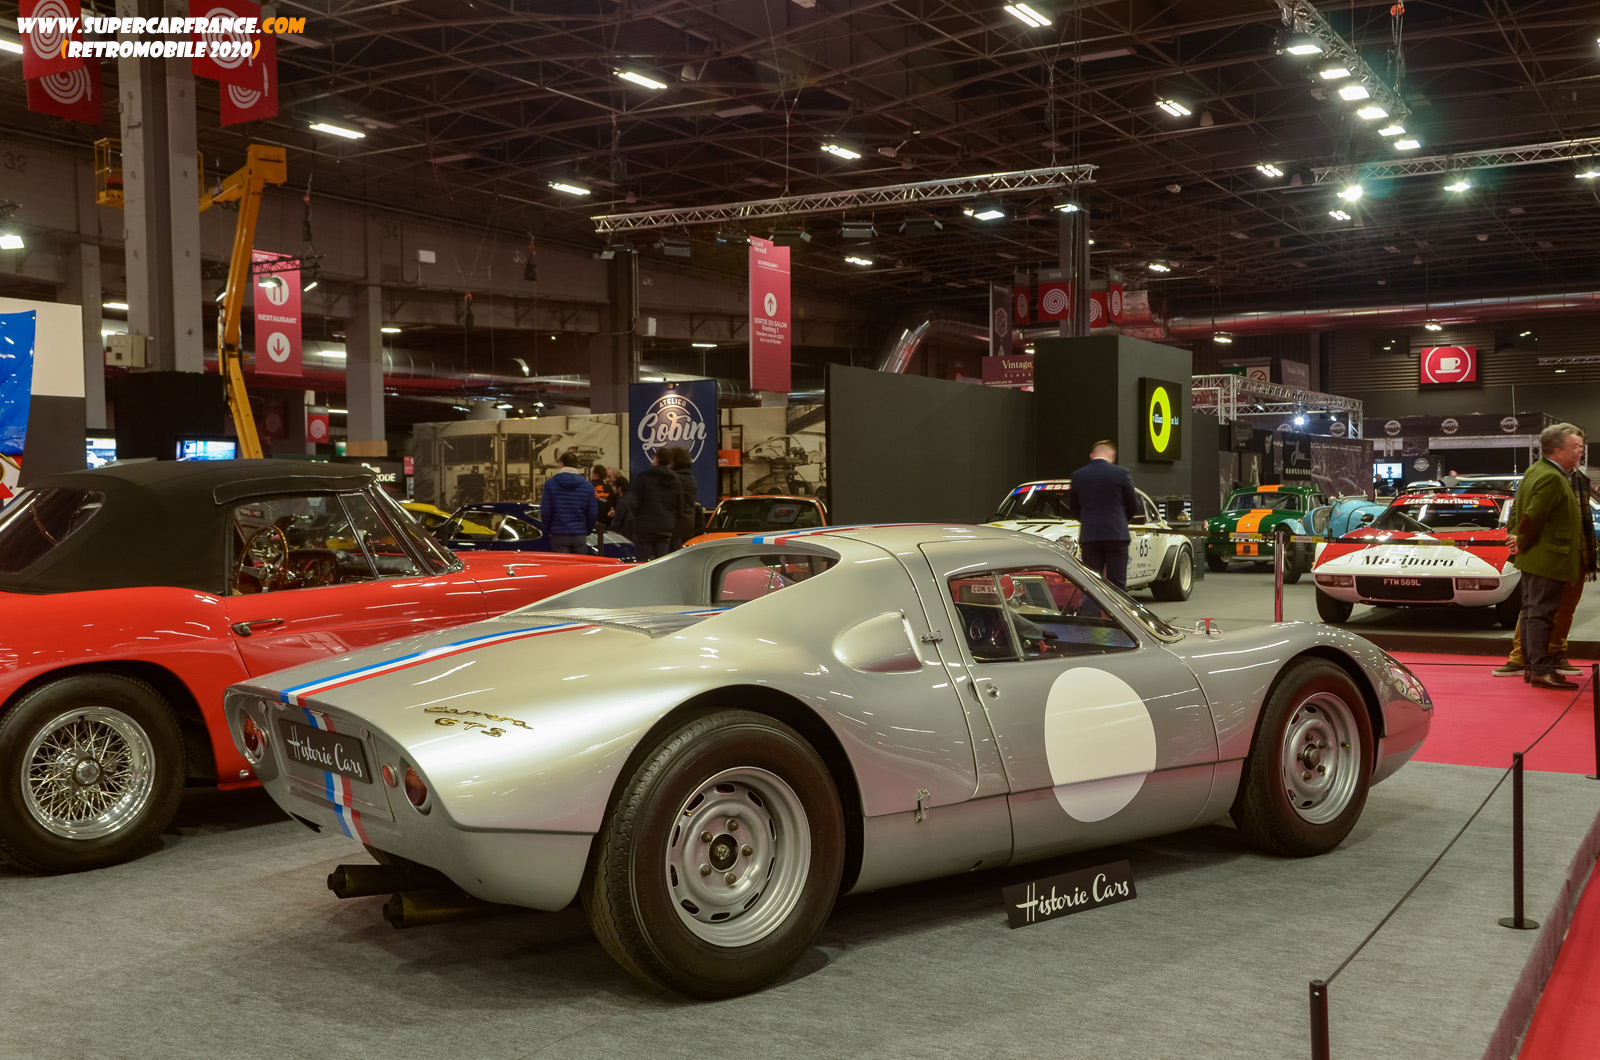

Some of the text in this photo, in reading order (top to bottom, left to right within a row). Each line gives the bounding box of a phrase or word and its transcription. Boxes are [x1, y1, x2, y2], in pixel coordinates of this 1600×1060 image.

[257, 313, 297, 324] RESTAURANT
[774, 320, 788, 328] SALON
[762, 325, 776, 334] Parking
[1002, 359, 1032, 369] Vintage
[659, 398, 687, 408] ATELIER
[637, 411, 707, 451] Gobin
[1139, 539, 1148, 557] 65
[1384, 578, 1421, 586] FTM 569L
[434, 717, 506, 738] GTS
[286, 725, 362, 778] Historic Cars
[1016, 873, 1129, 922] Historic Cars
